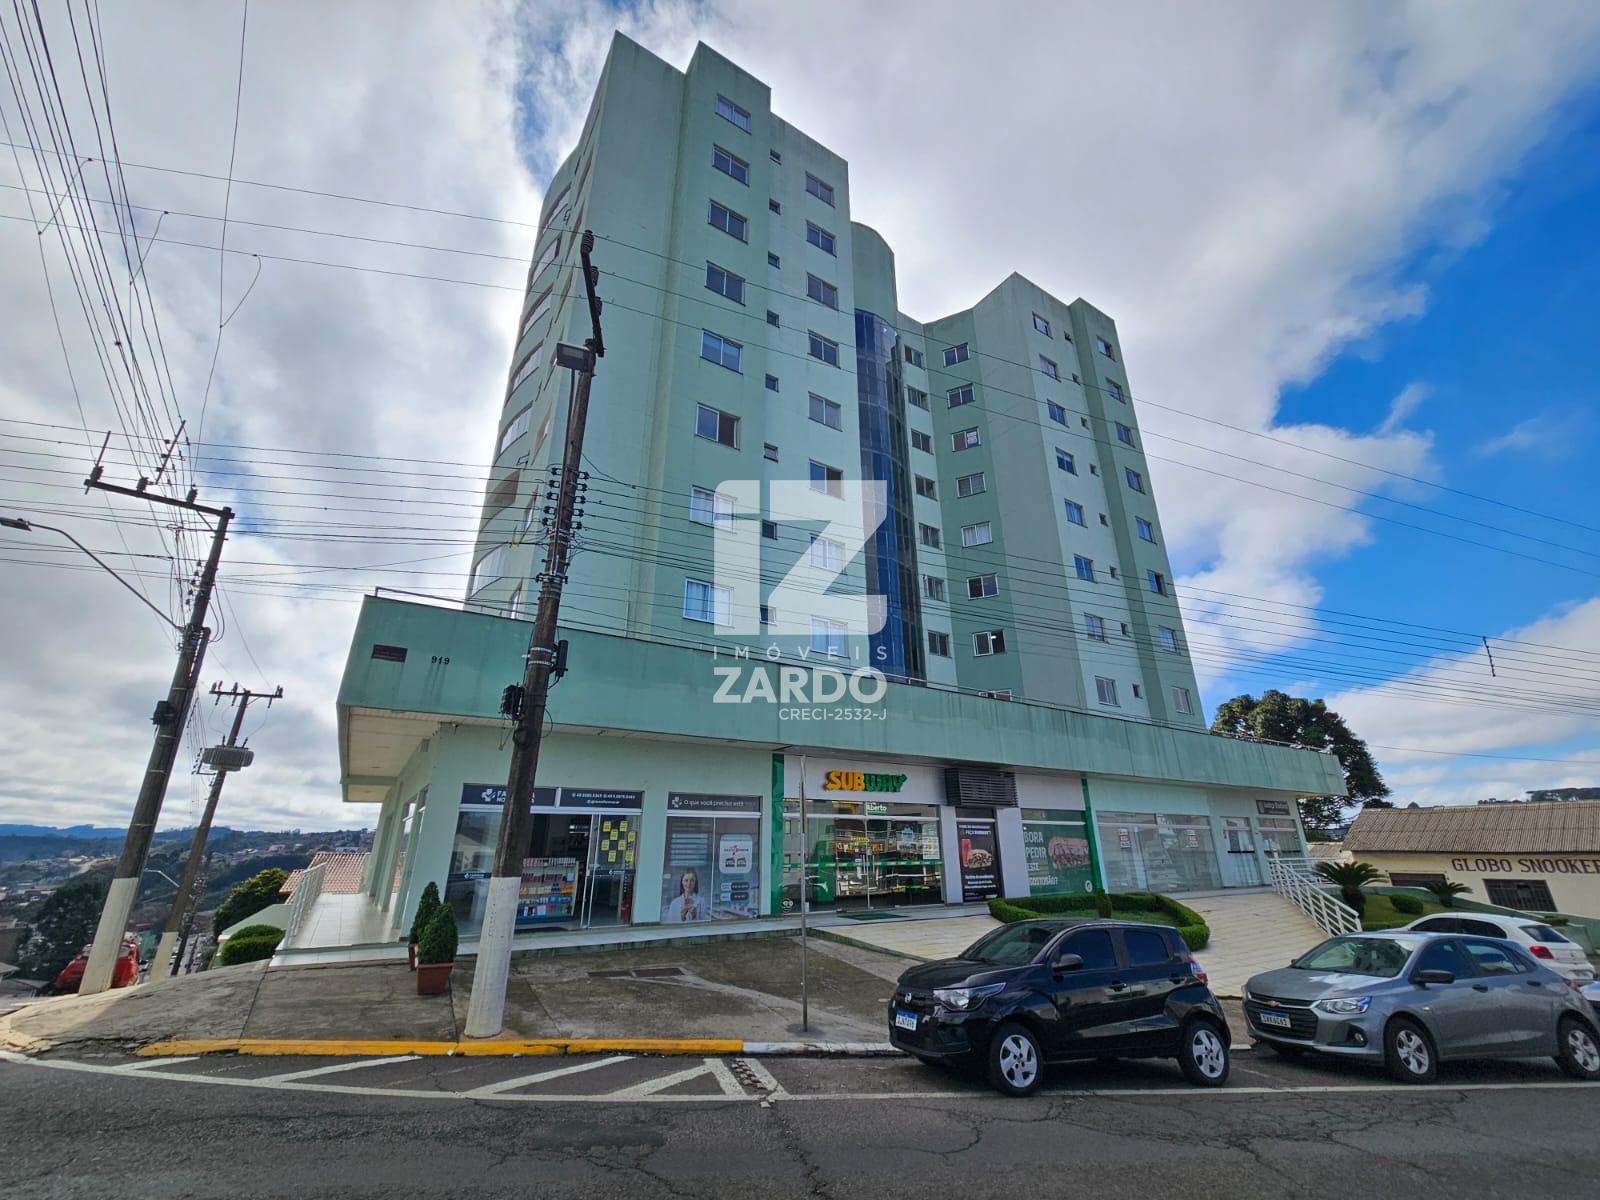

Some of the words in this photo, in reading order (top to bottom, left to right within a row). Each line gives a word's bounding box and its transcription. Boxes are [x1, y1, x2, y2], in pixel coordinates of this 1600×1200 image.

[432, 655, 450, 665] 919
[825, 770, 908, 792] SUBWAY
[1023, 831, 1044, 843] BORA
[1025, 846, 1047, 859] PEDIR
[1451, 858, 1512, 872] GLOBO
